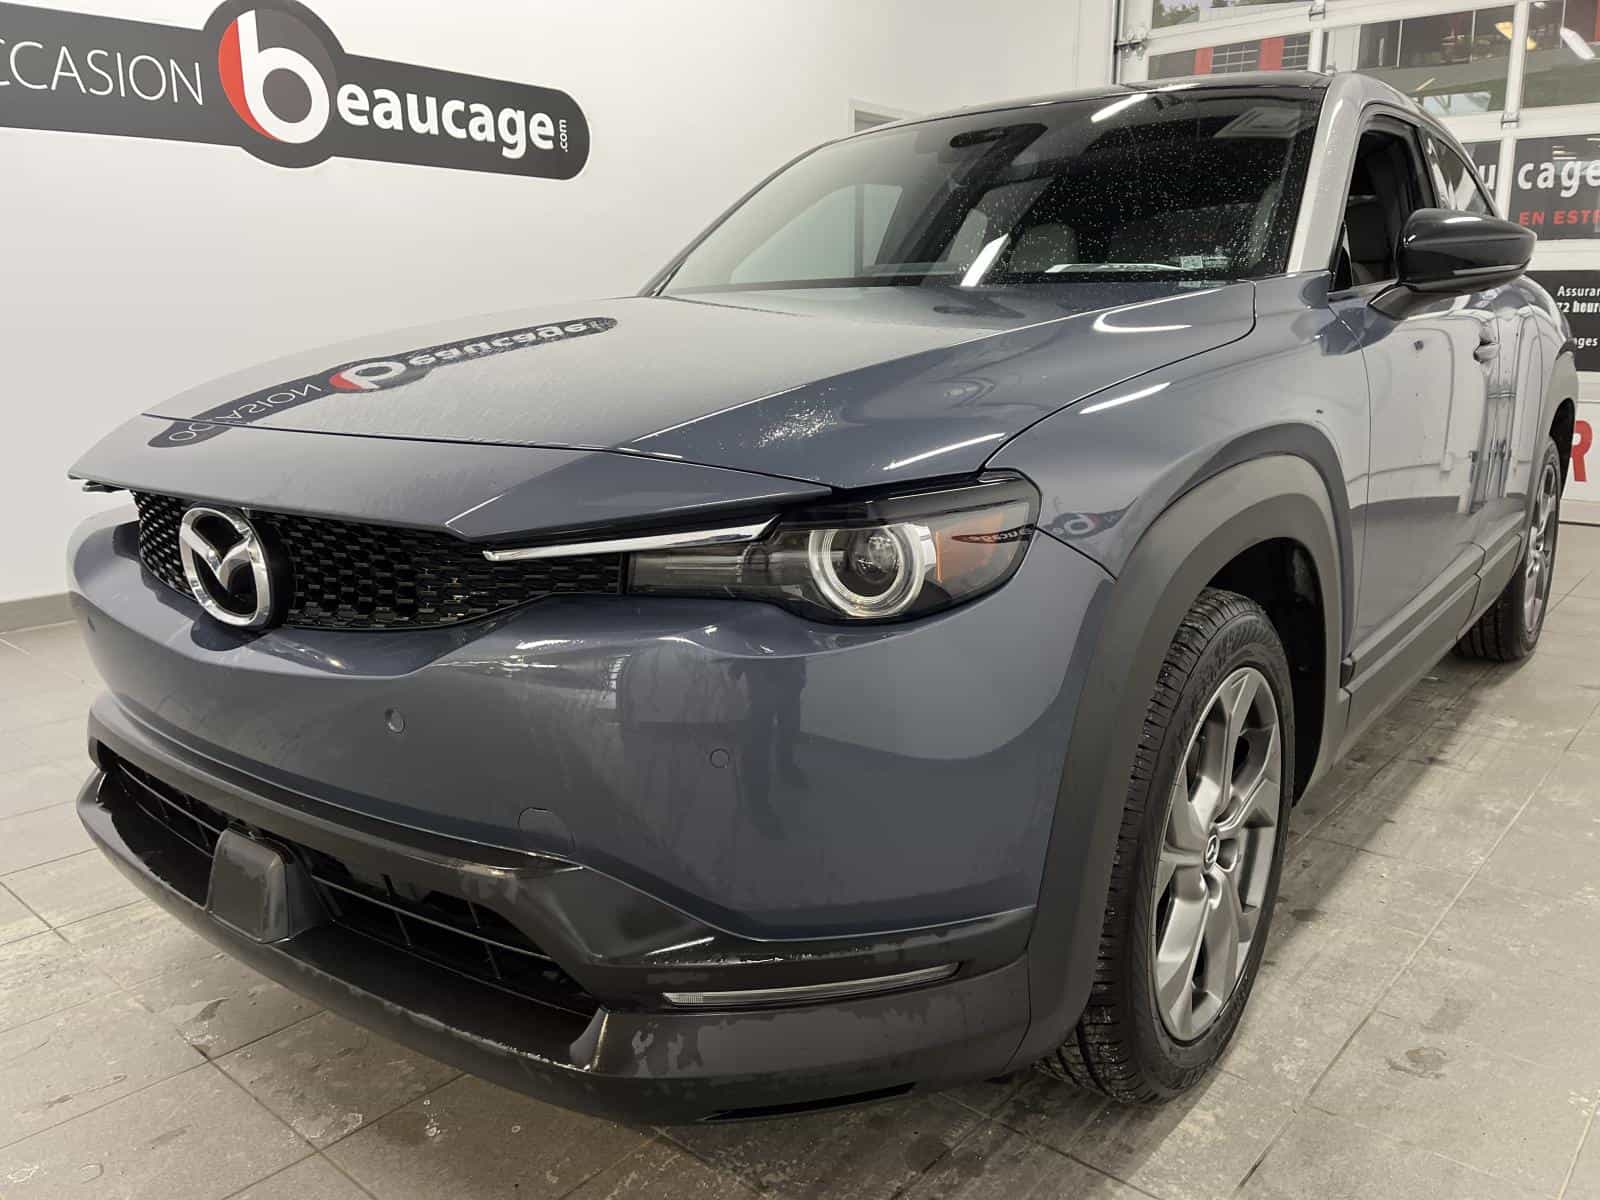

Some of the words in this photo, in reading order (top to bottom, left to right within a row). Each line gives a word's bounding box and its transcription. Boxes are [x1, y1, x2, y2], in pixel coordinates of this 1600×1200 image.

[0, 38, 203, 106] CASION
[559, 118, 569, 153] .com
[1519, 211, 1545, 225] EN
